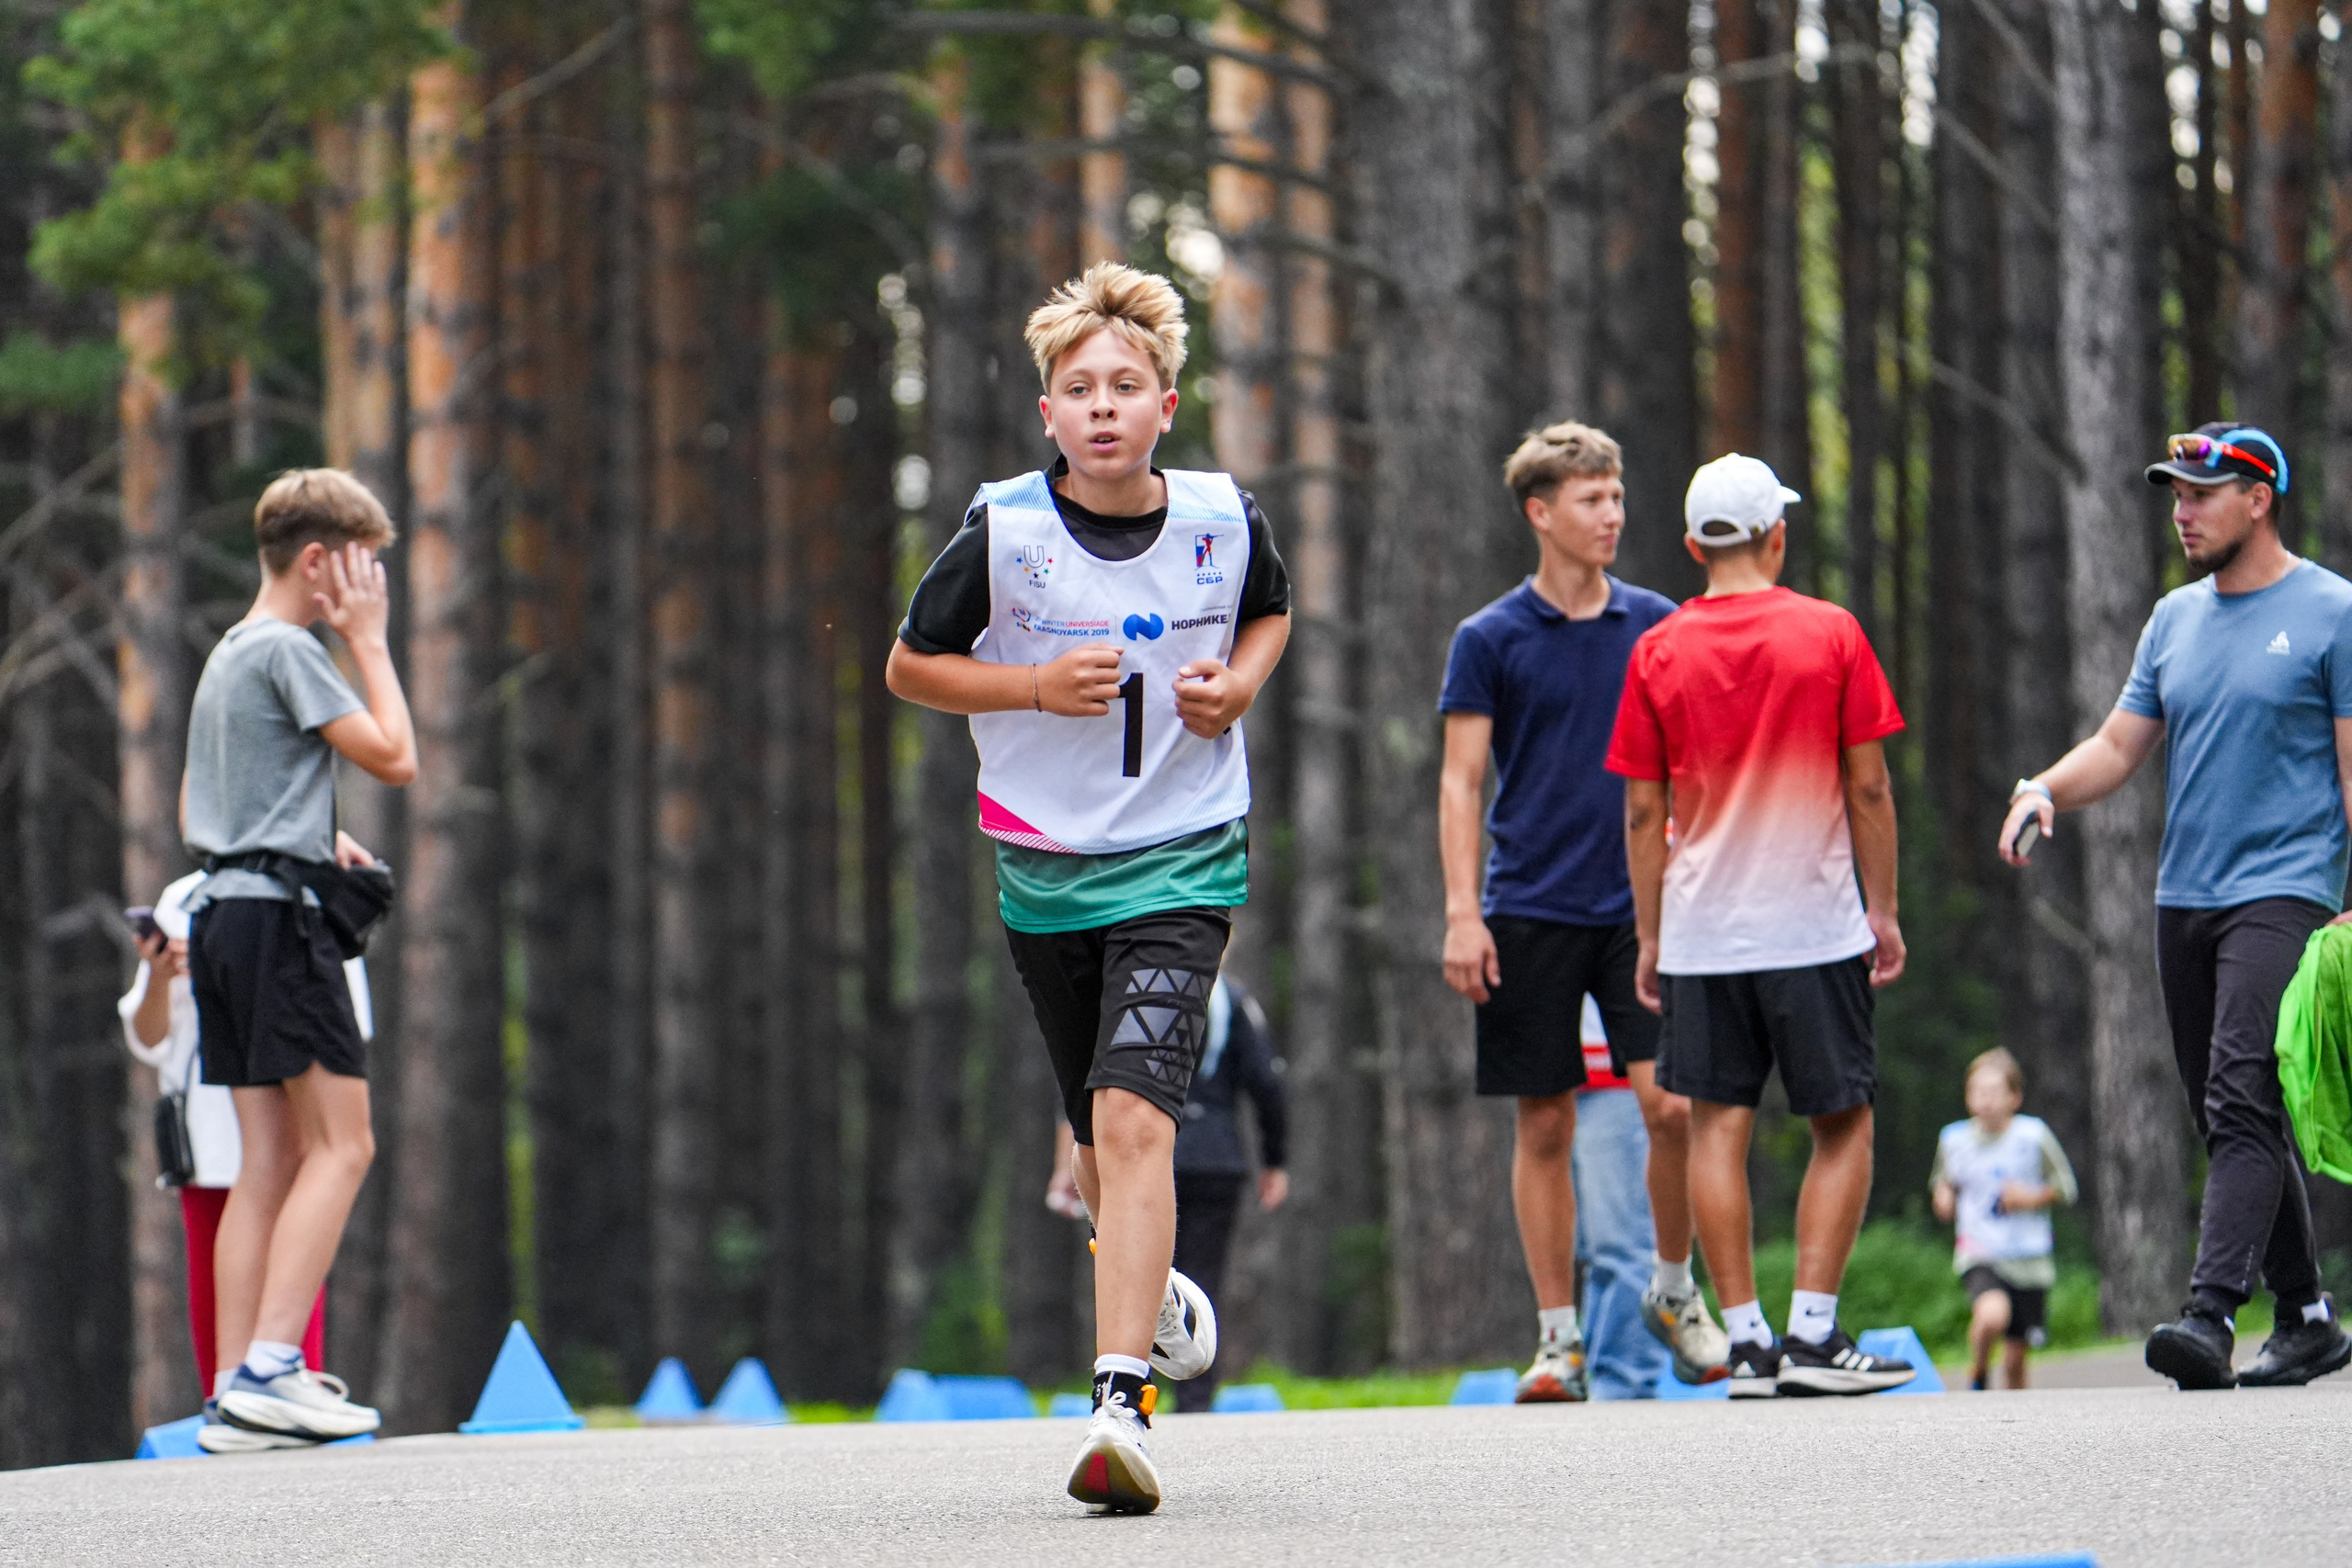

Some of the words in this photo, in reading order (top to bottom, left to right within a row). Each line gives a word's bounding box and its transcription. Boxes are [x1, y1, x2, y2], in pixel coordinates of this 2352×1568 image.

[1023, 546, 1046, 569] U
[1029, 580, 1046, 589] FISU
[1197, 576, 1223, 585] СБР
[1091, 628, 1110, 637] 2019
[1117, 672, 1144, 778] 1
